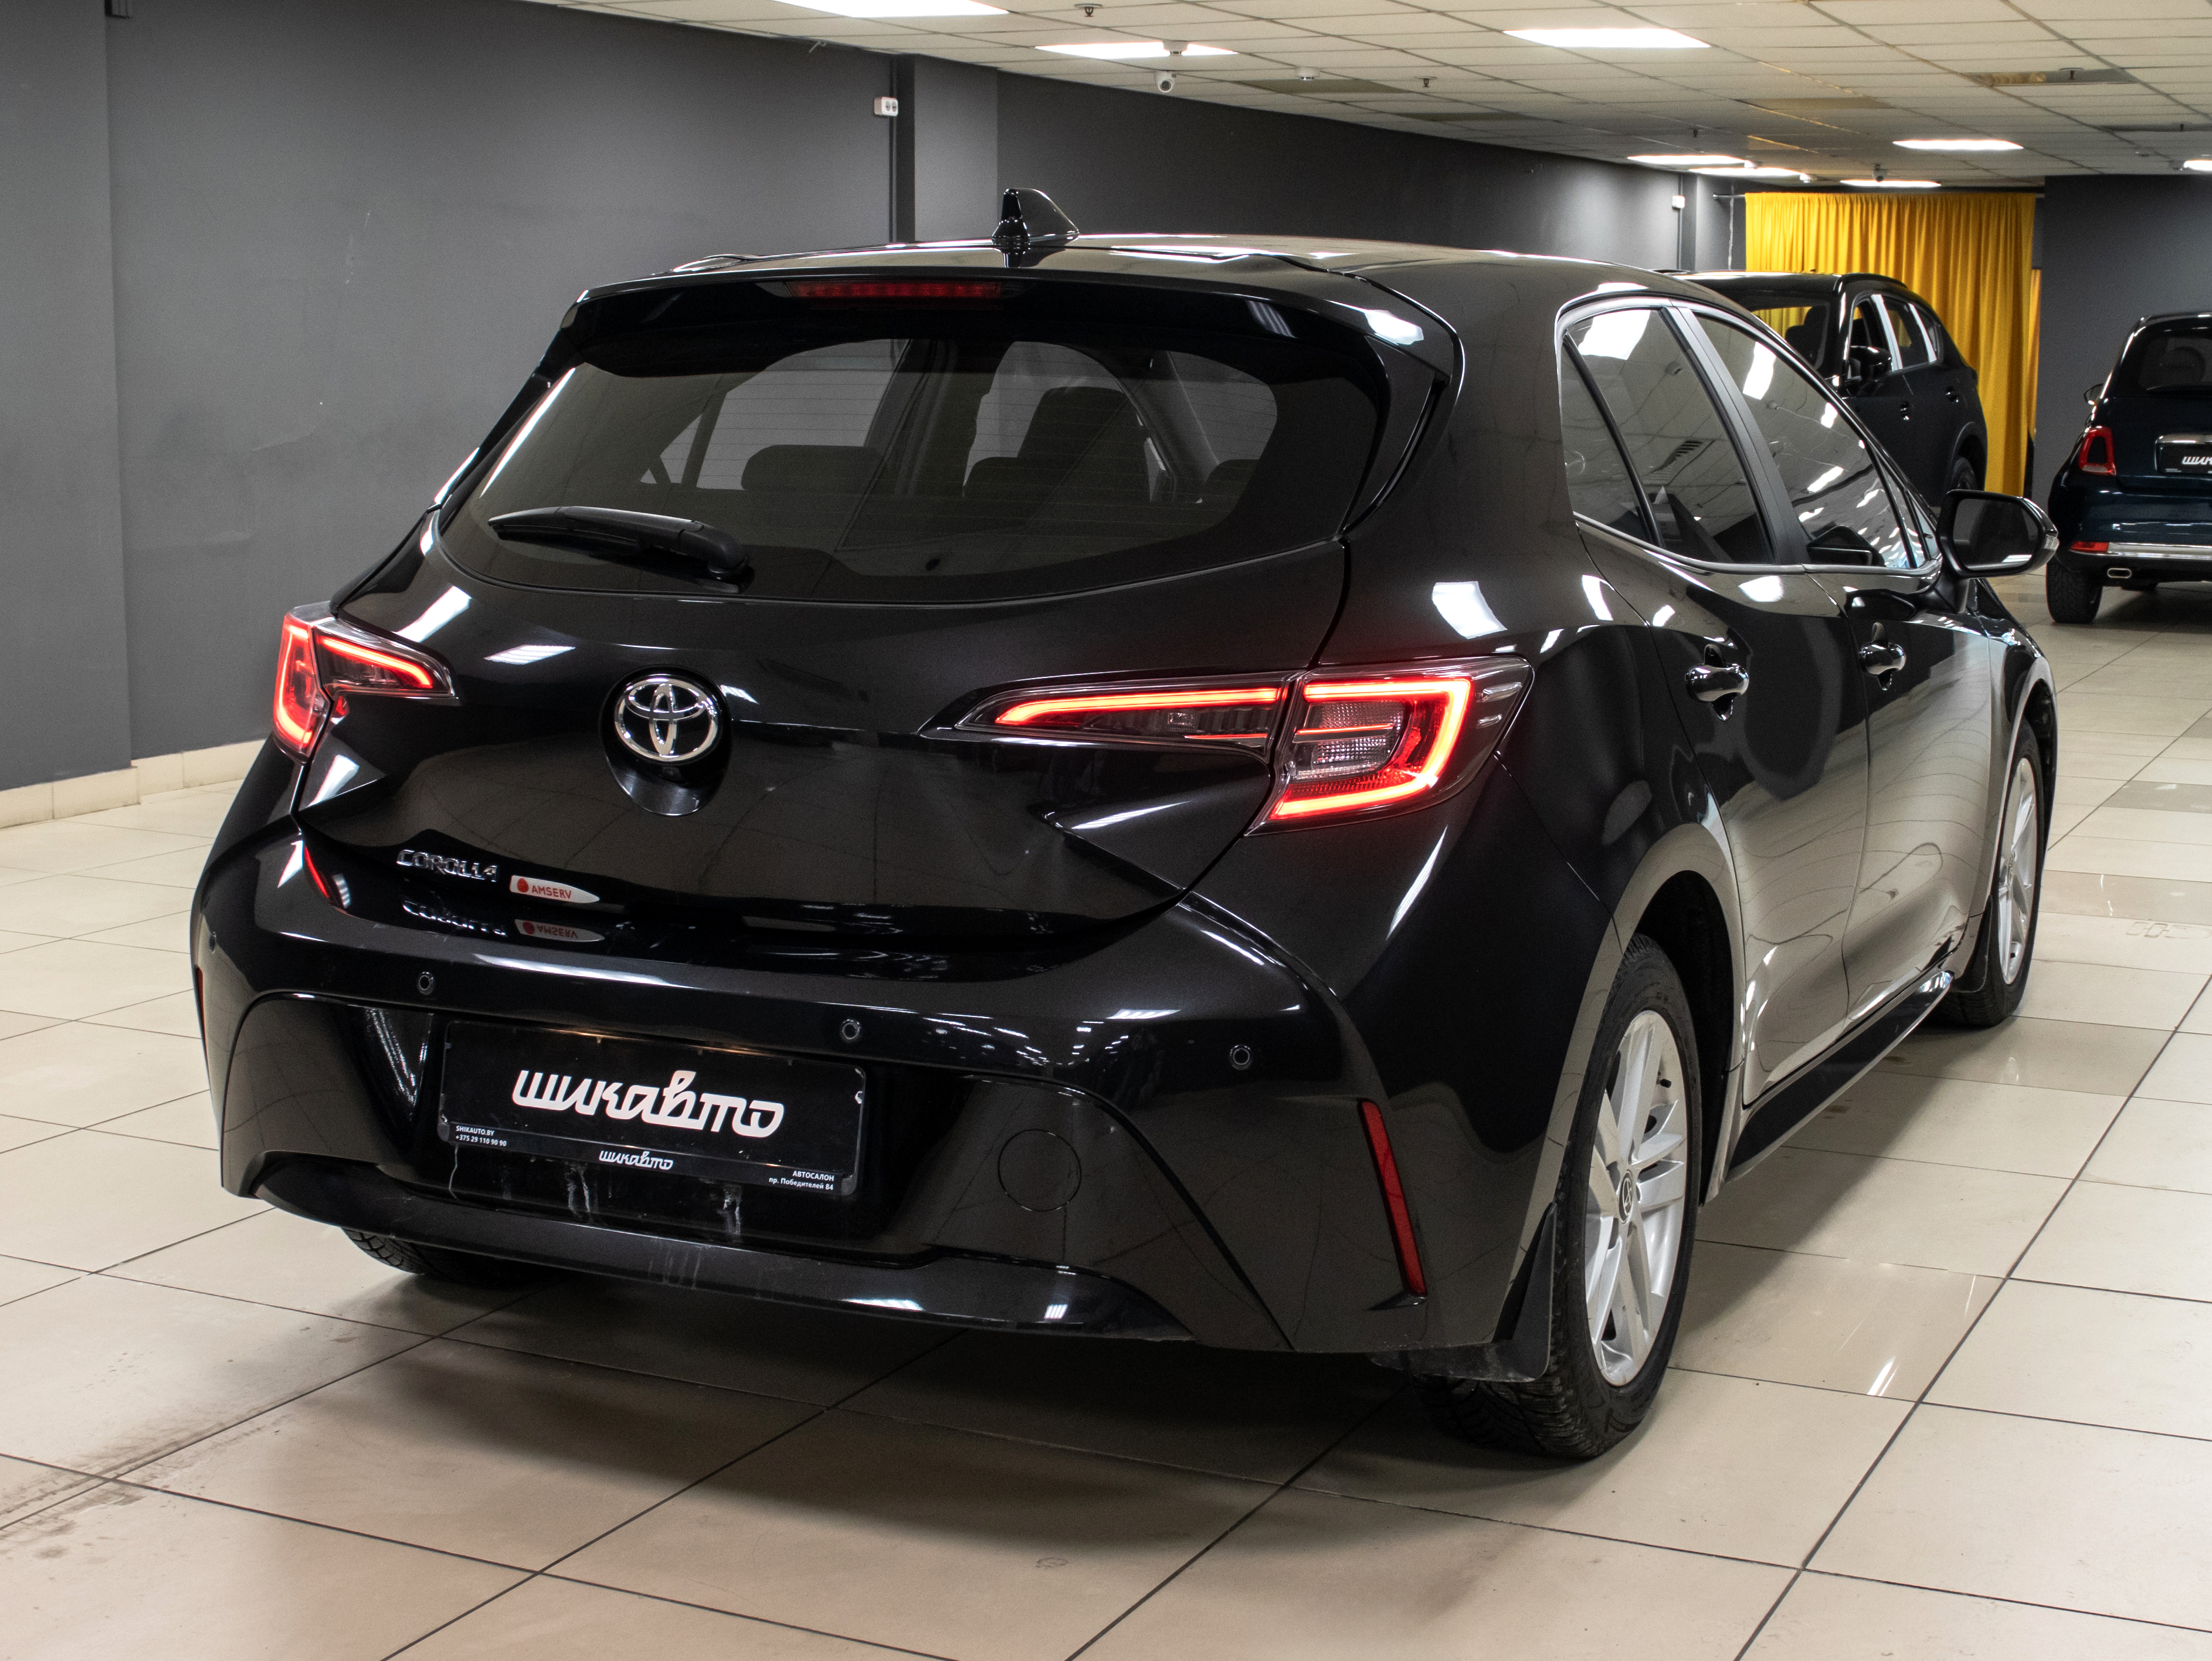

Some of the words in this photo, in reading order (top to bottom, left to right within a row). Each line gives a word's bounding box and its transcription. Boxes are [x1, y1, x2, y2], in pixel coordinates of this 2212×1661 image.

[396, 849, 498, 883] COROLLA
[531, 884, 572, 900] AMSERV
[512, 1070, 785, 1138] шикавто
[456, 1125, 495, 1136] SHIKAUTO.BY
[456, 1134, 470, 1142] +375
[598, 1150, 674, 1170] шикавто
[792, 1170, 834, 1182] АВТОСАЛОН
[781, 1178, 824, 1189] Победителей
